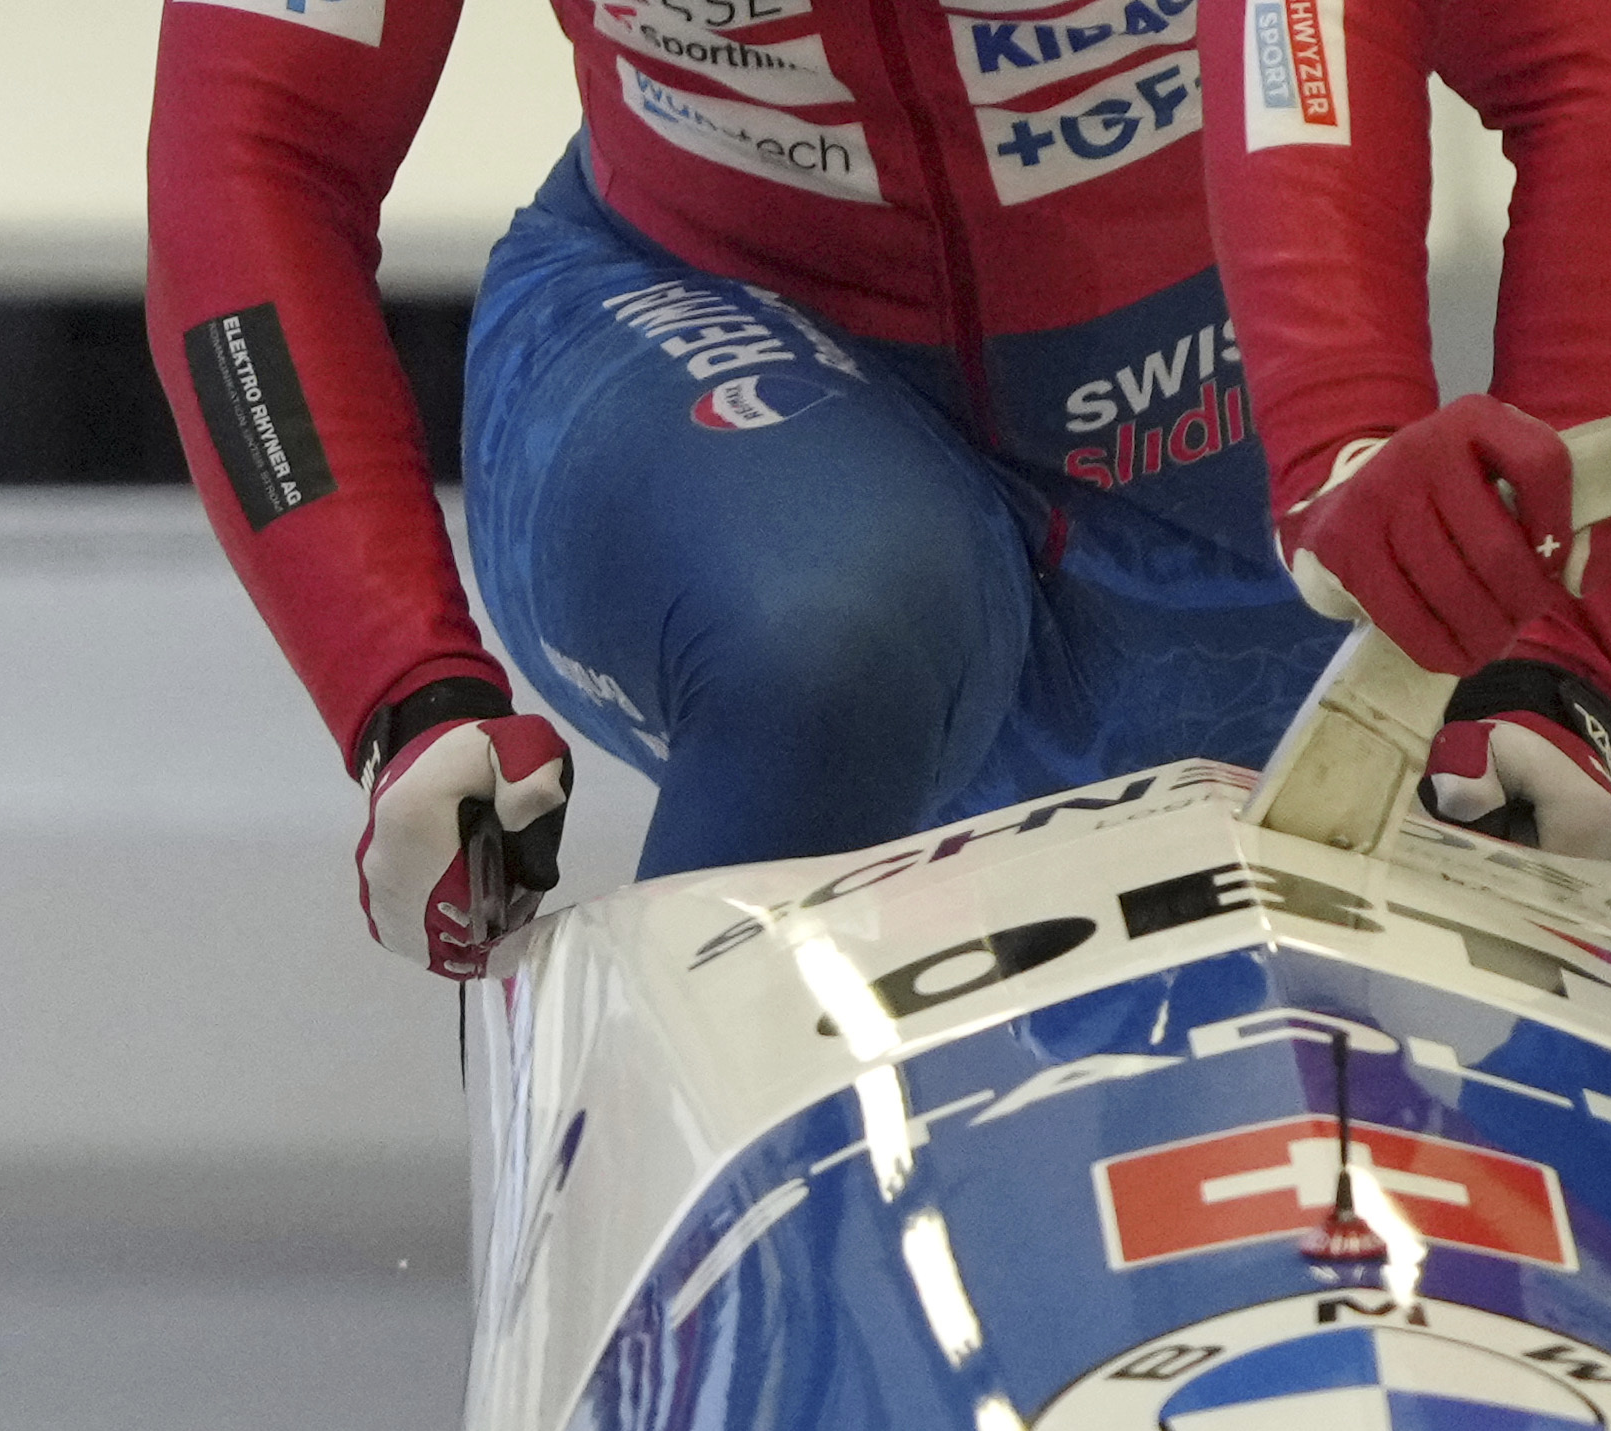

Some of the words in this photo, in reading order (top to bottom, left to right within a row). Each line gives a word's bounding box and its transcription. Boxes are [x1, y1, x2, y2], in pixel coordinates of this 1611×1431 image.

[1259, 11, 1289, 100] SPORT
[223, 316, 262, 402] ELEKTRO
[251, 404, 290, 478] RHYNER
[281, 480, 302, 505] AG
